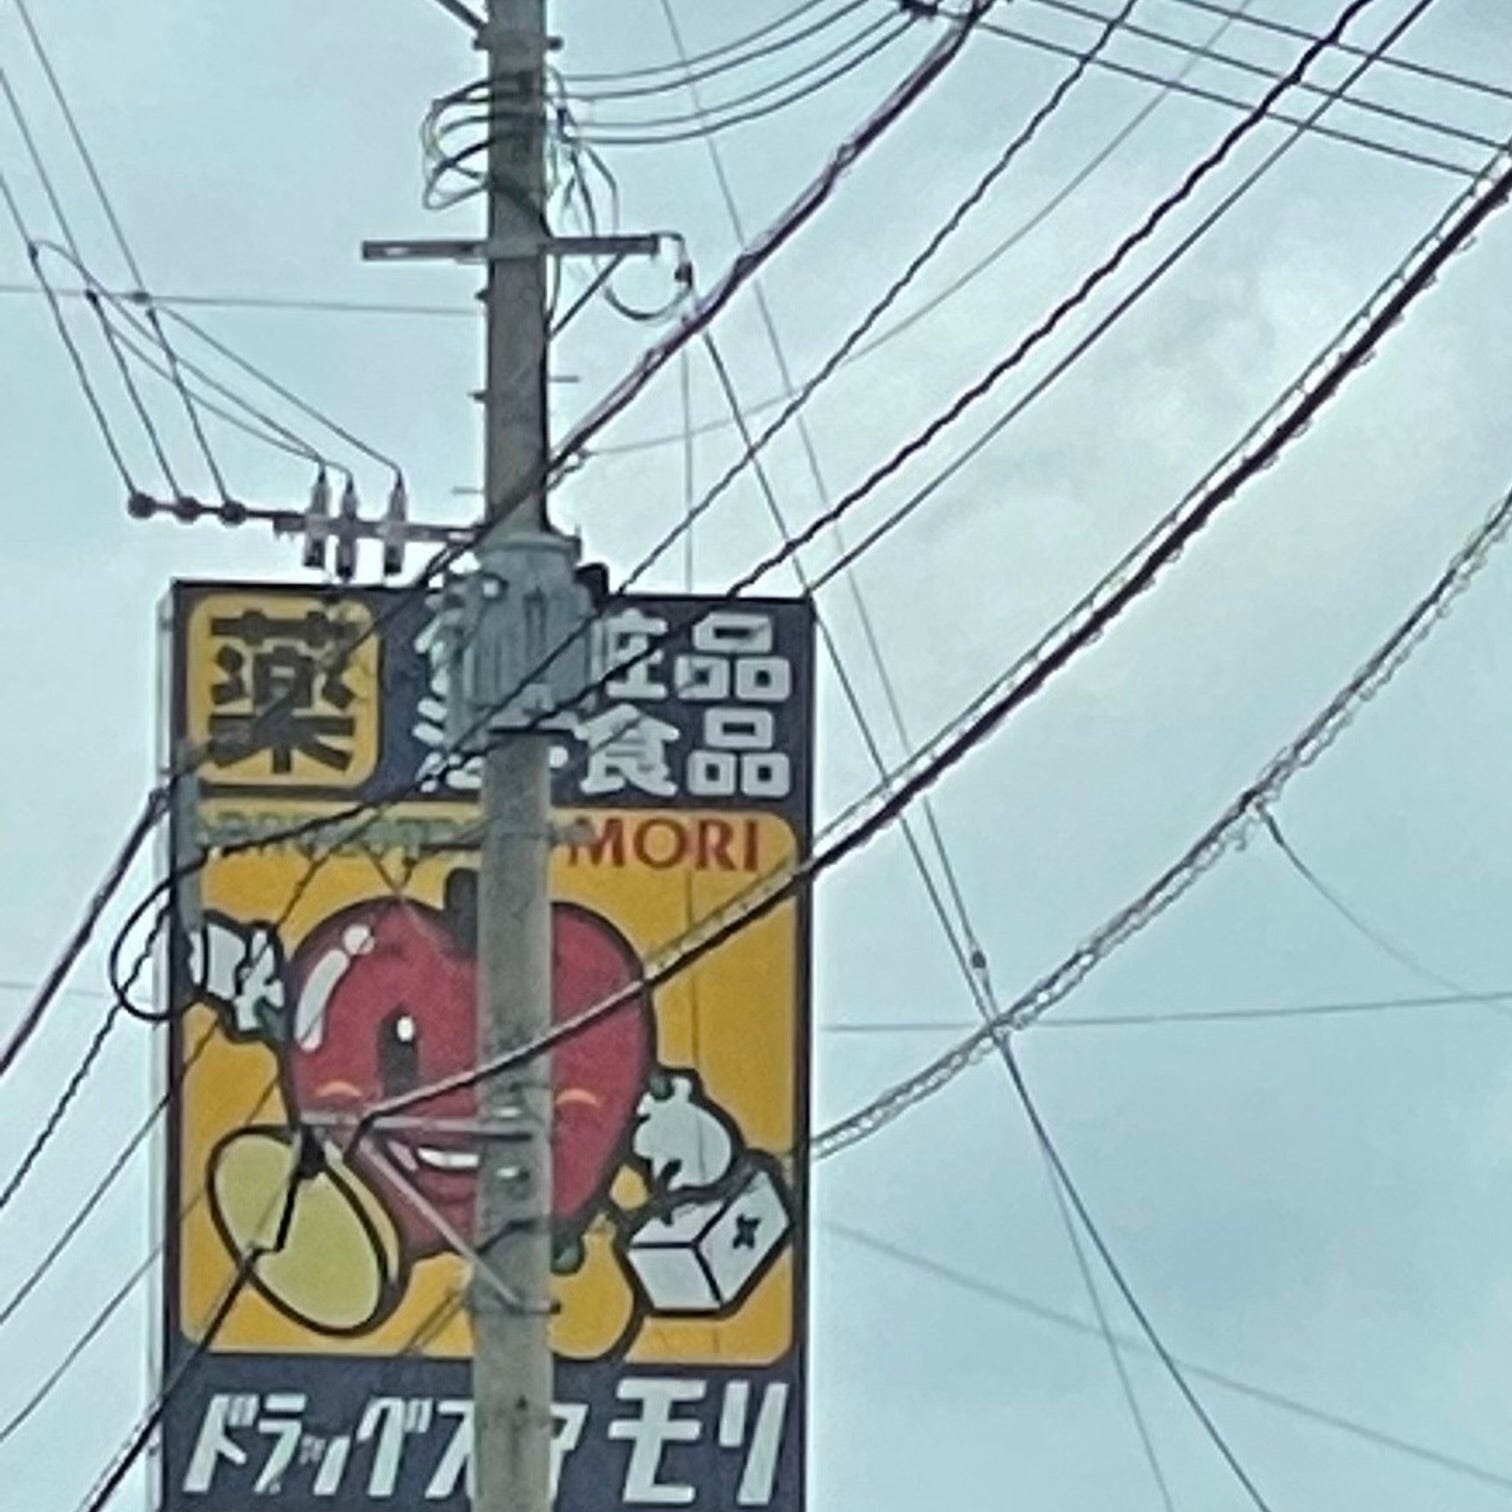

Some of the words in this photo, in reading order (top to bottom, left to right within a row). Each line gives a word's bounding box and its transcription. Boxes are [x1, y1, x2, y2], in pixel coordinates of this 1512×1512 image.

[209, 611, 355, 773] 薬
[415, 605, 790, 699] 粧品
[568, 817, 760, 874] MORI
